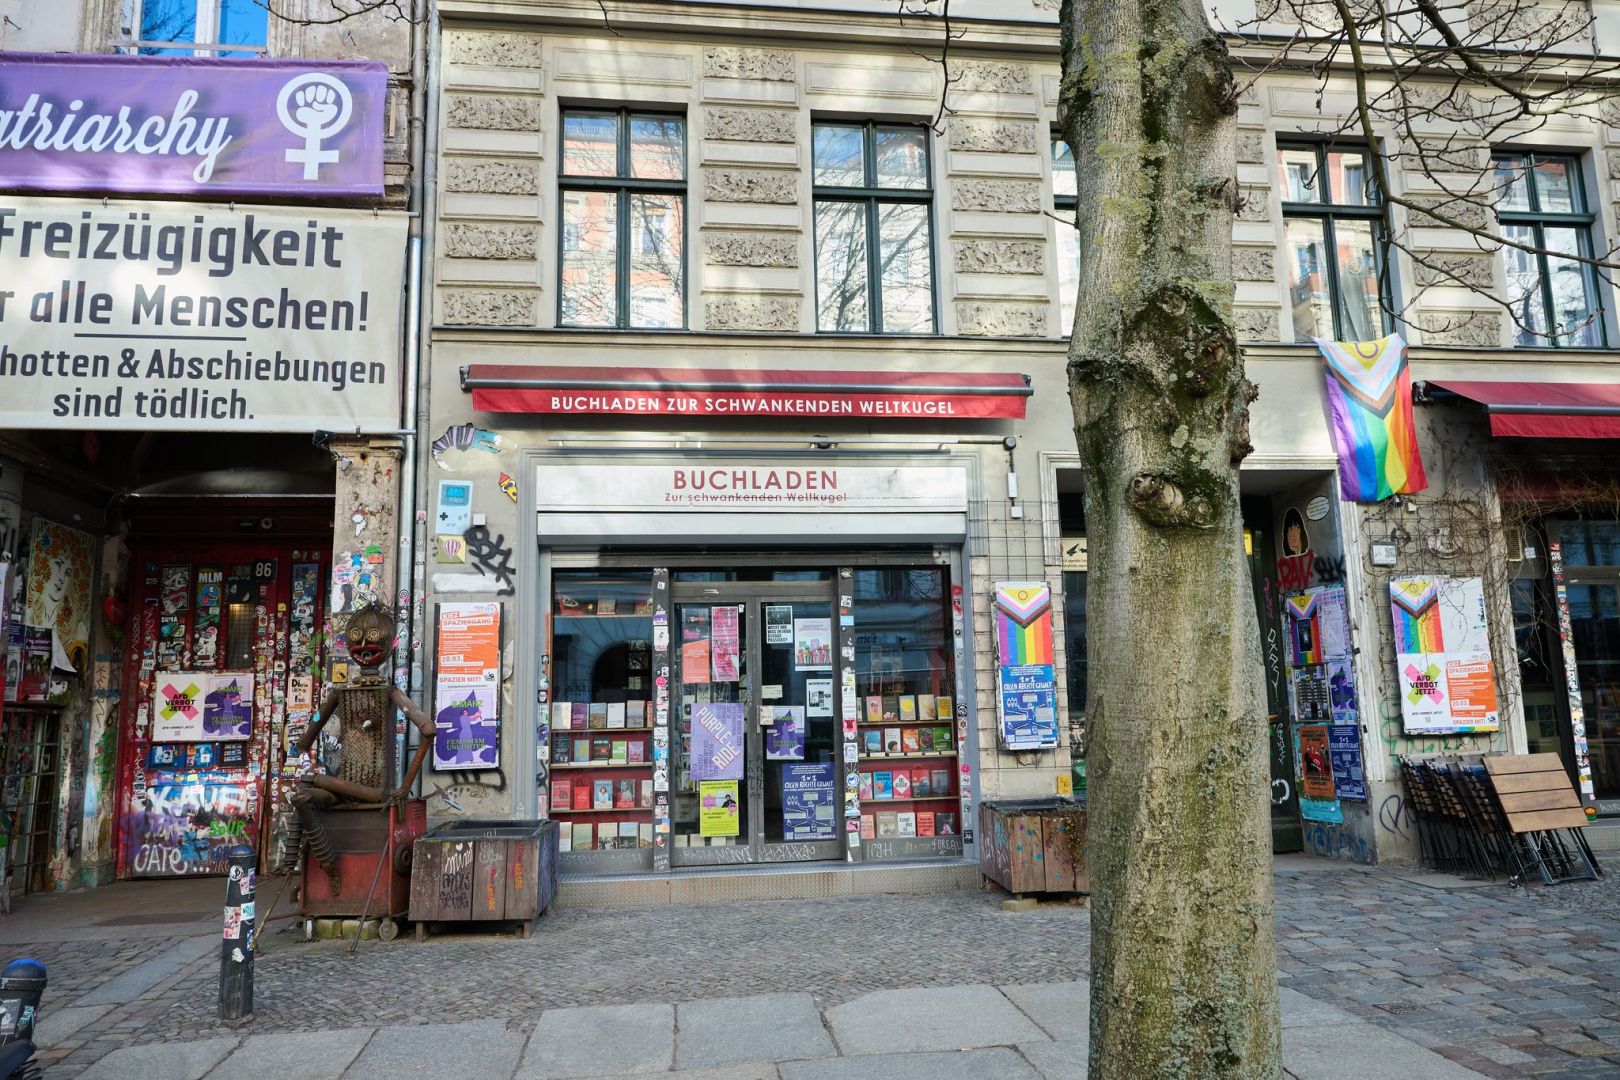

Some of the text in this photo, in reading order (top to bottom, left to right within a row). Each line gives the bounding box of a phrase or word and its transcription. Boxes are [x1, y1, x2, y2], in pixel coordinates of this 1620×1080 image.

[0, 208, 343, 278] Freizügigkeit
[30, 280, 113, 324] alle
[131, 285, 368, 332] Menschen!
[117, 348, 140, 379] &
[146, 345, 385, 391] Abschiebungen
[53, 387, 254, 420] sind tödlich.
[551, 396, 955, 414] BUCHLADEN ZUR SCHWANKENDEN WELTKUGEL
[673, 470, 838, 491] BUCHLADEN
[665, 492, 848, 504] Zur schwankenden Weltkugel
[255, 562, 272, 577] 86
[696, 706, 732, 743] PURPLE
[712, 741, 740, 770] RIDE
